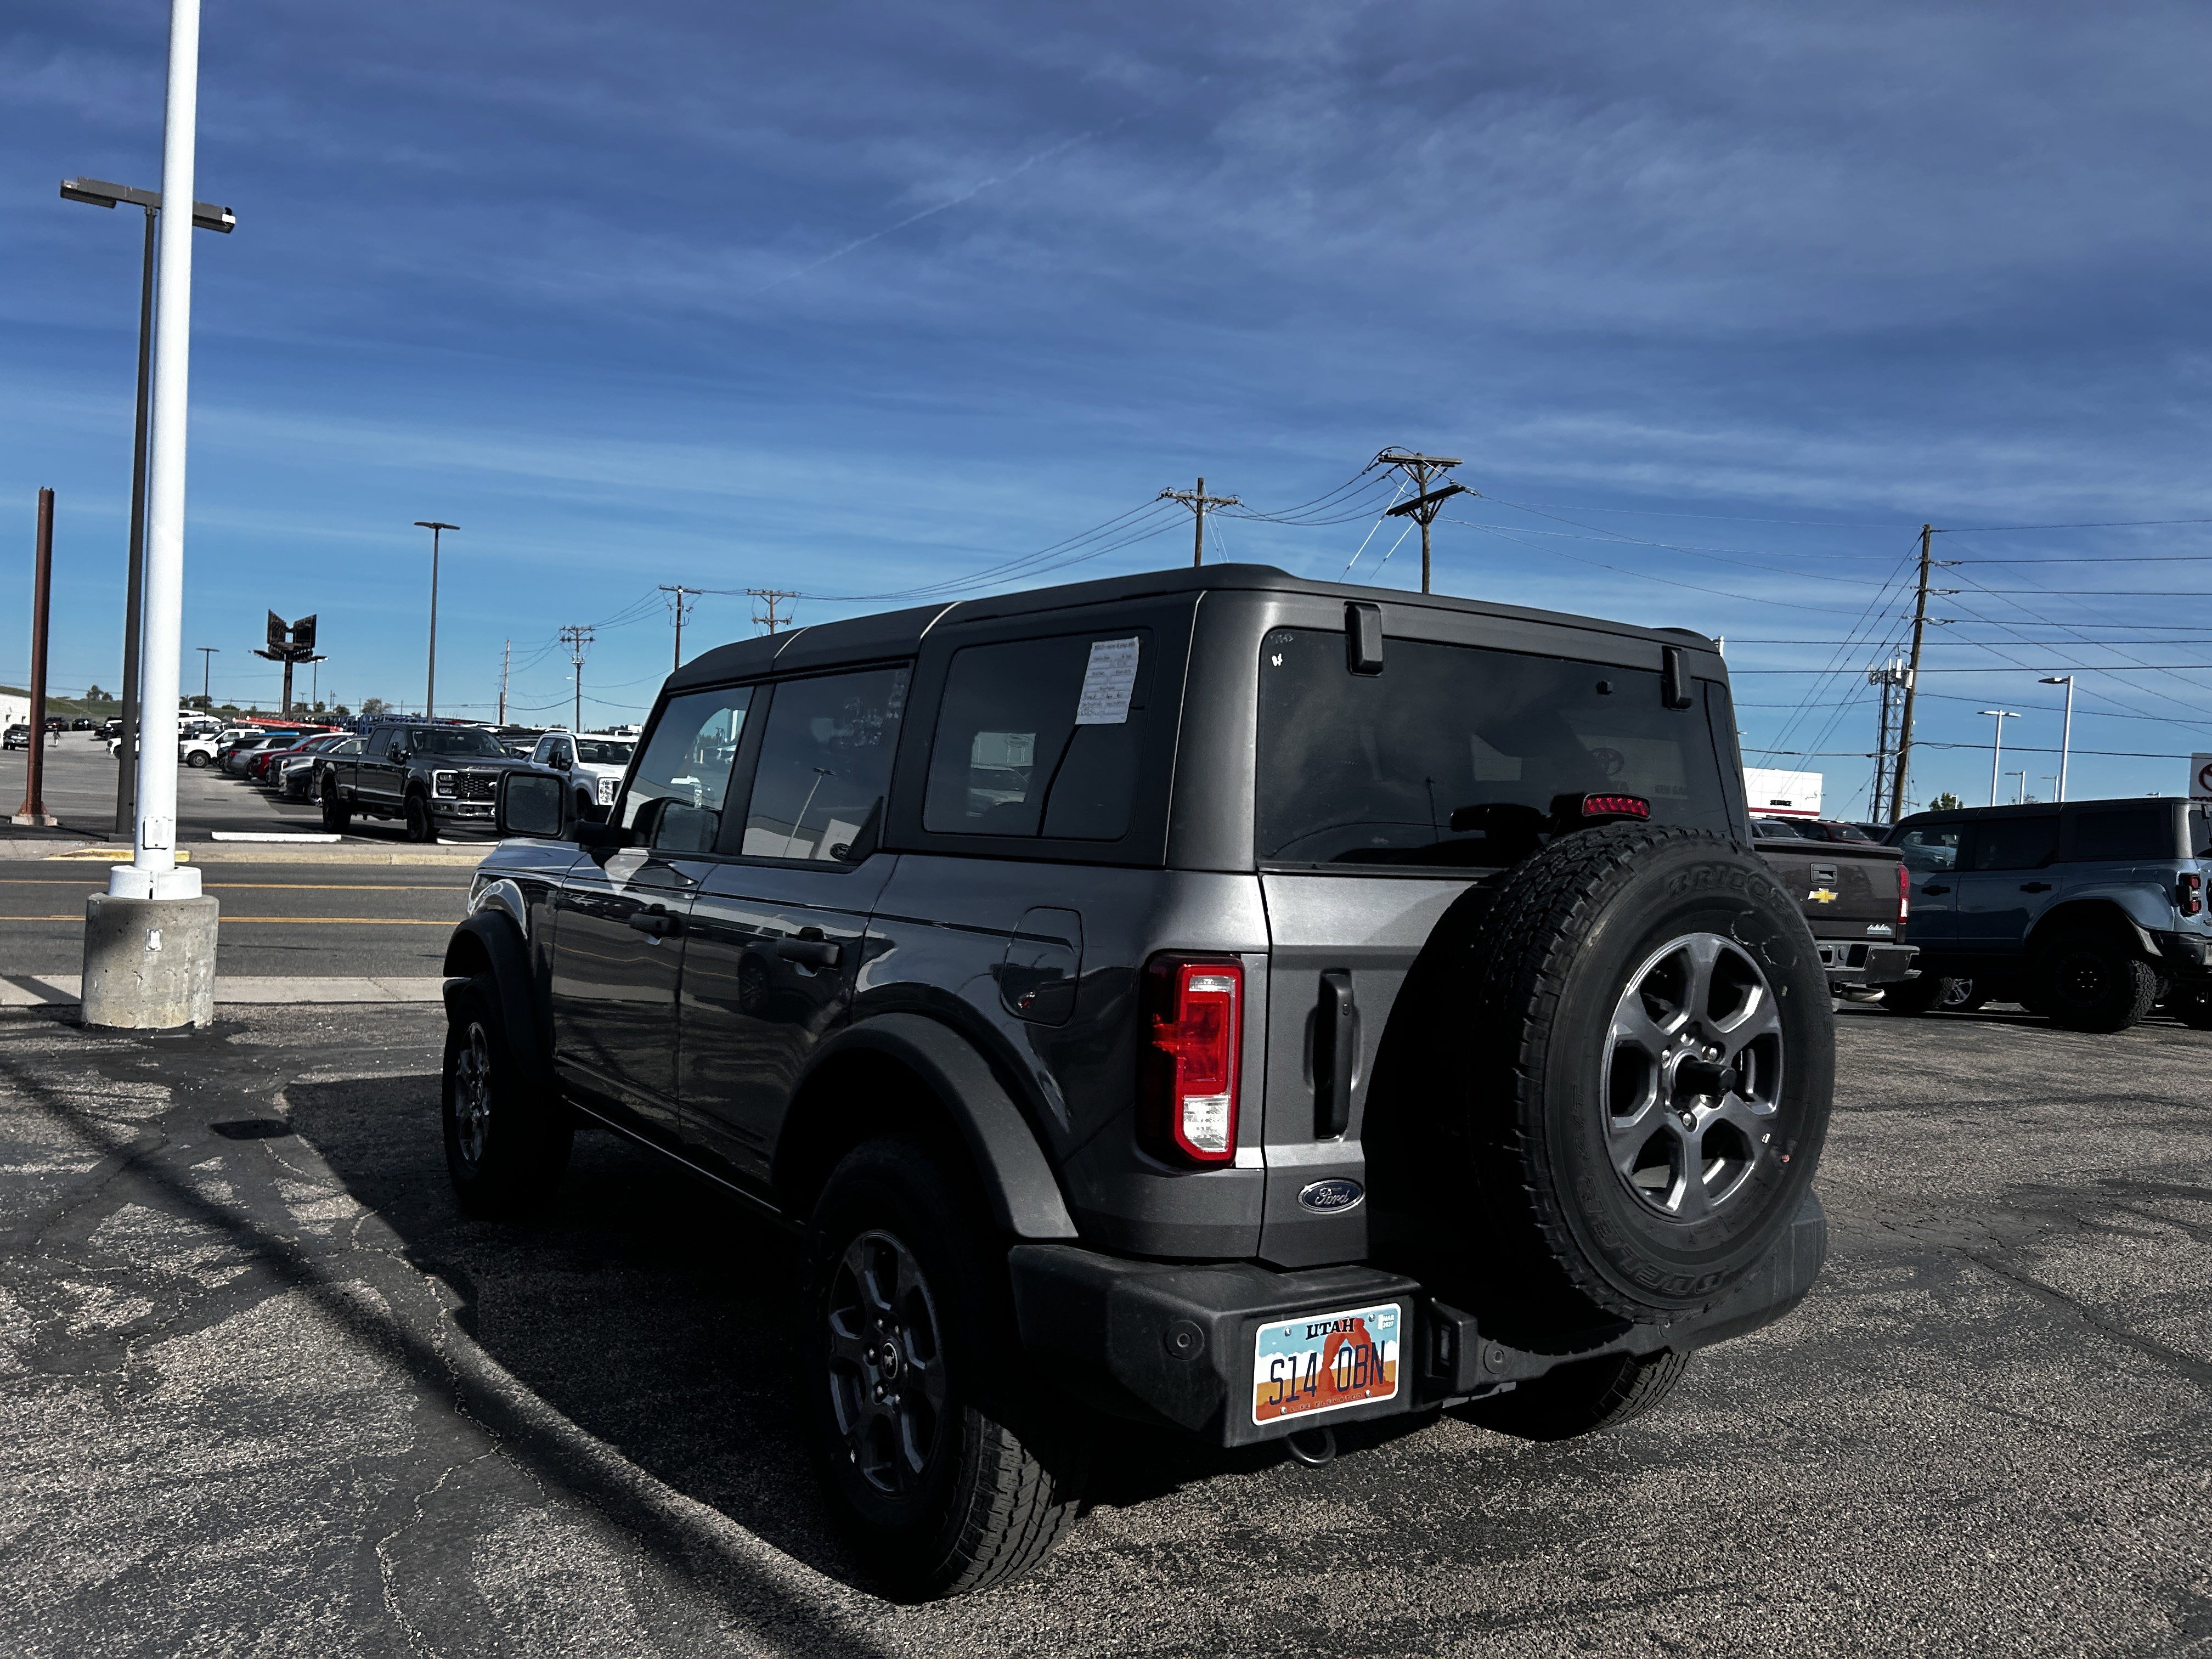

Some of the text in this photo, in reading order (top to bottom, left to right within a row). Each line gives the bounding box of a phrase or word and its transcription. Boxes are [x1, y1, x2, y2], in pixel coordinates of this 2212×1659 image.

[1314, 1187, 1351, 1206] Ford
[1306, 1318, 1355, 1340] UTAH
[1269, 1352, 1317, 1405] S14
[1290, 1393, 1362, 1412] LIFE ELEVATED
